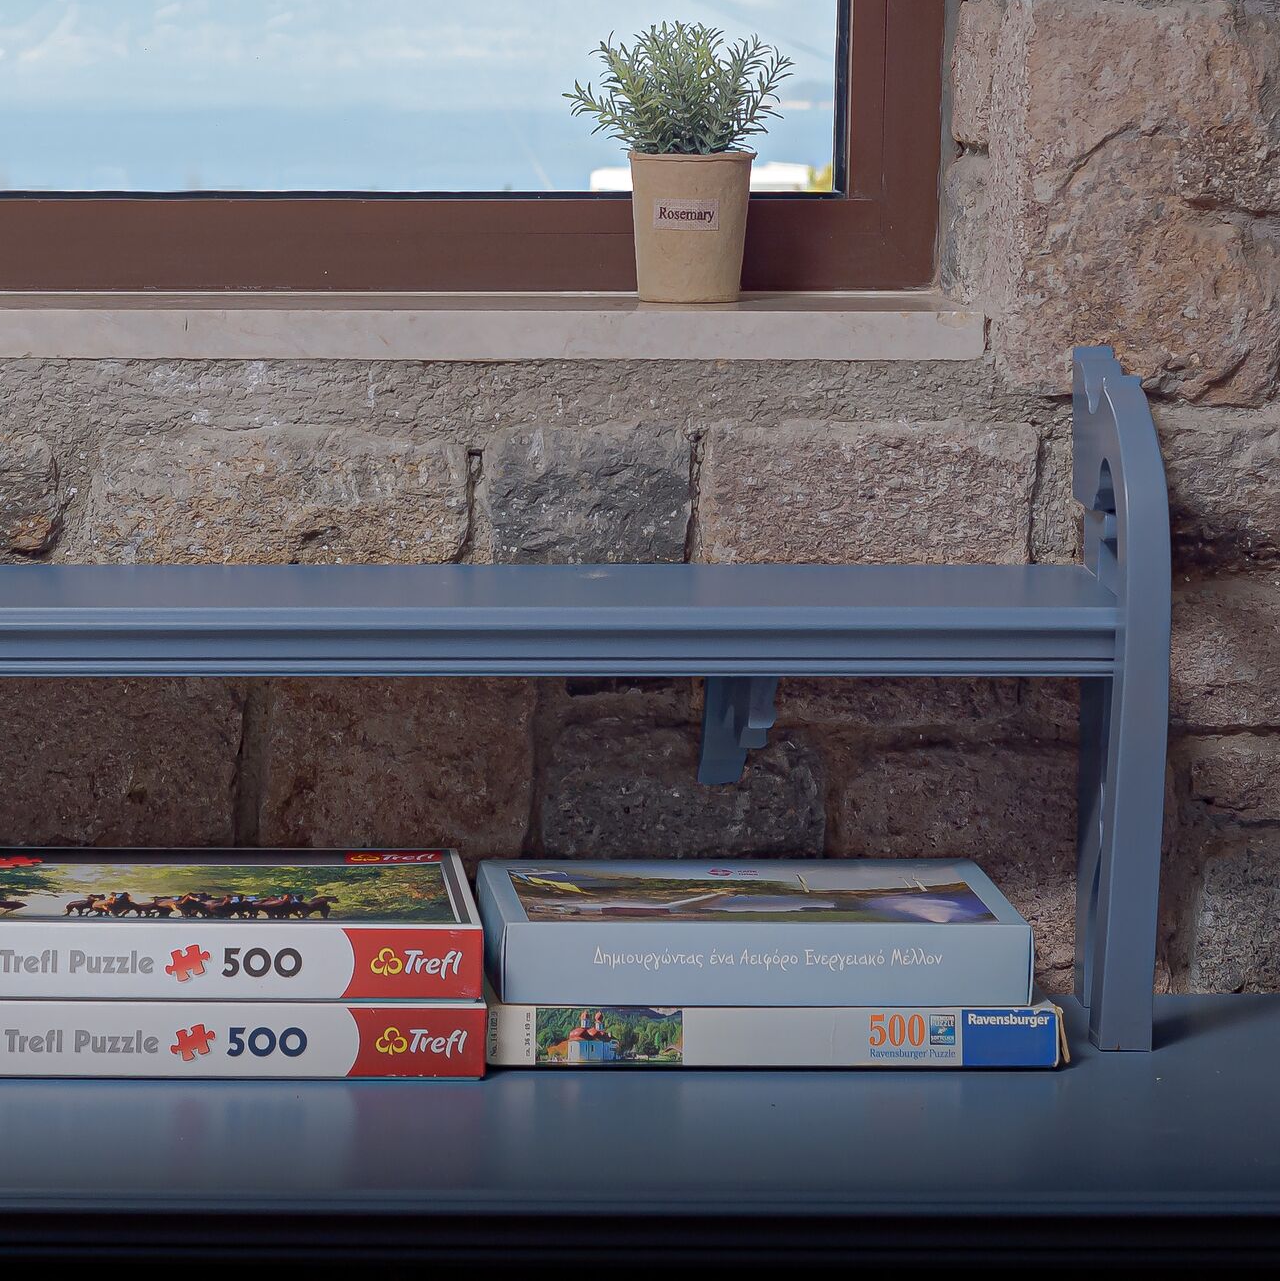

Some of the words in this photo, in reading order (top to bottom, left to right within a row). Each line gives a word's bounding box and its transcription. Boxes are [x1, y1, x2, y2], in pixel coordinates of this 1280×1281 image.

[658, 206, 714, 223] Rosemary
[381, 853, 435, 861] Trefl
[0, 949, 58, 974] Trefl
[69, 949, 154, 974] Puzzle
[221, 947, 303, 979] 500
[404, 948, 462, 981] Trefl
[593, 946, 704, 970] Δημιουργώντας
[709, 948, 734, 965] ένα
[739, 948, 799, 970] Αειφόρο
[804, 948, 886, 970] Ενεργειακό
[890, 948, 943, 965] Μέλλον
[869, 1014, 925, 1047] 500
[968, 1013, 1050, 1028] Ravensburger
[5, 1029, 63, 1054] Trefl
[74, 1029, 159, 1054] Puzzle
[227, 1027, 308, 1058] 500
[409, 1028, 468, 1061] Trefl
[870, 1049, 927, 1060] Ravensburger
[929, 1049, 955, 1058] Puzzle
